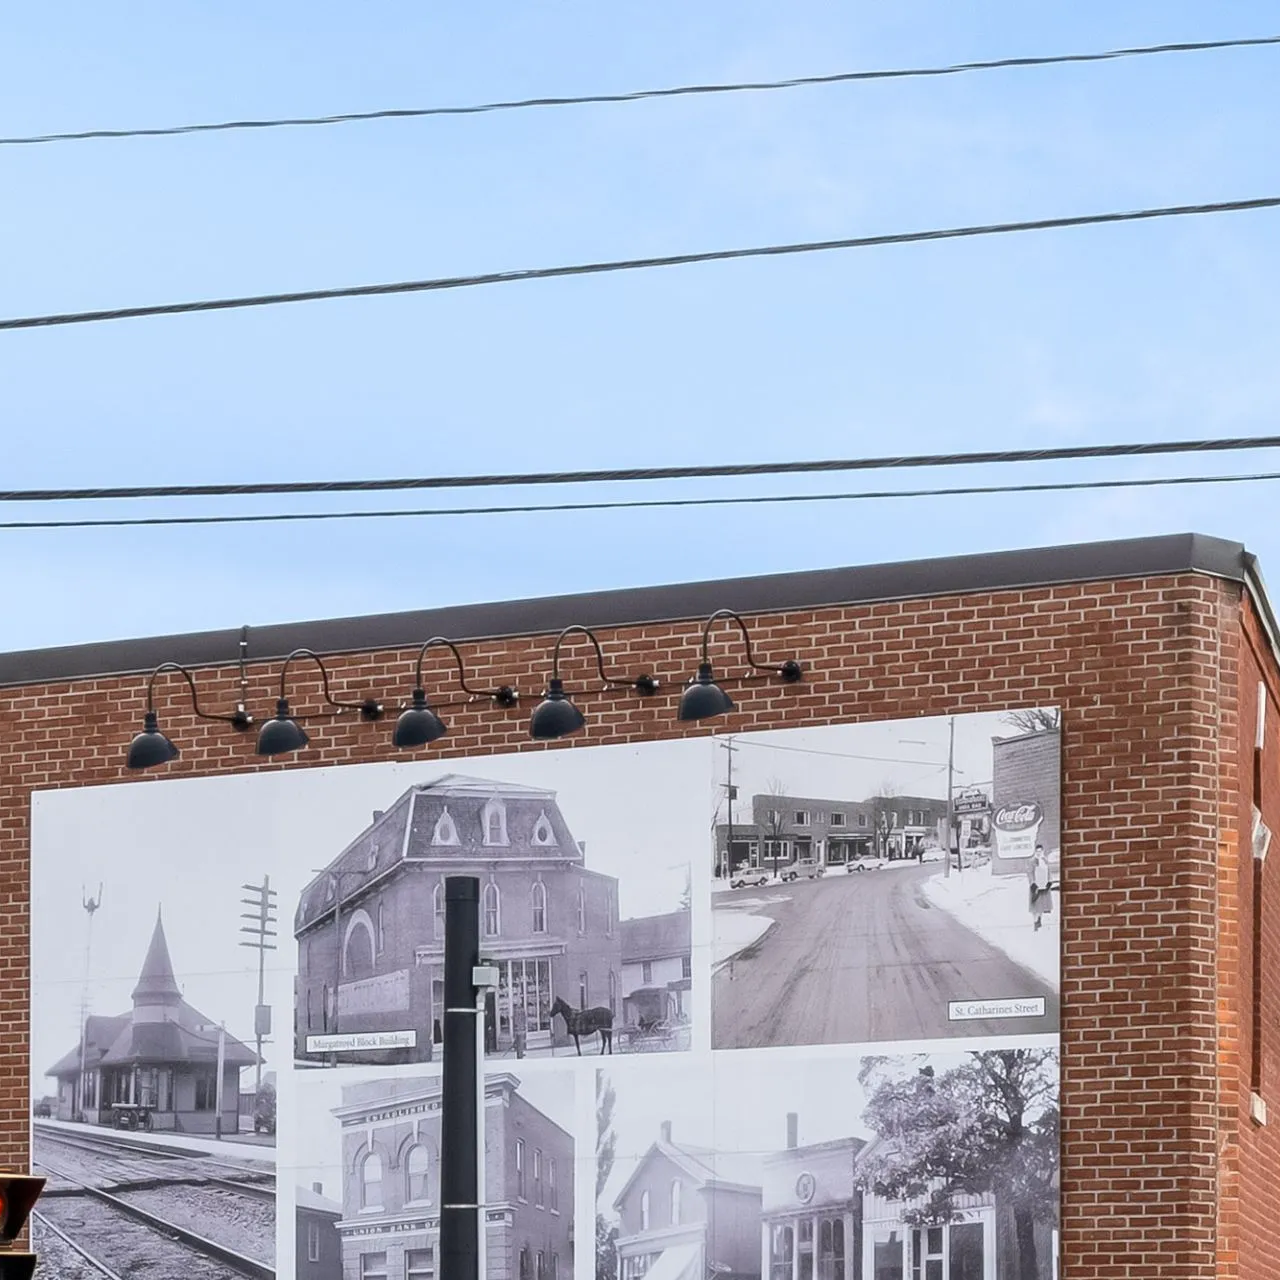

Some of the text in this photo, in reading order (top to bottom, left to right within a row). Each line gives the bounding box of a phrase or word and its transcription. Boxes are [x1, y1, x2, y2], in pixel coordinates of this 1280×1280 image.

[967, 1005, 1012, 1016] Catharines
[1014, 1003, 1038, 1013] Street
[357, 1036, 377, 1047] Block
[379, 1034, 410, 1046] Building
